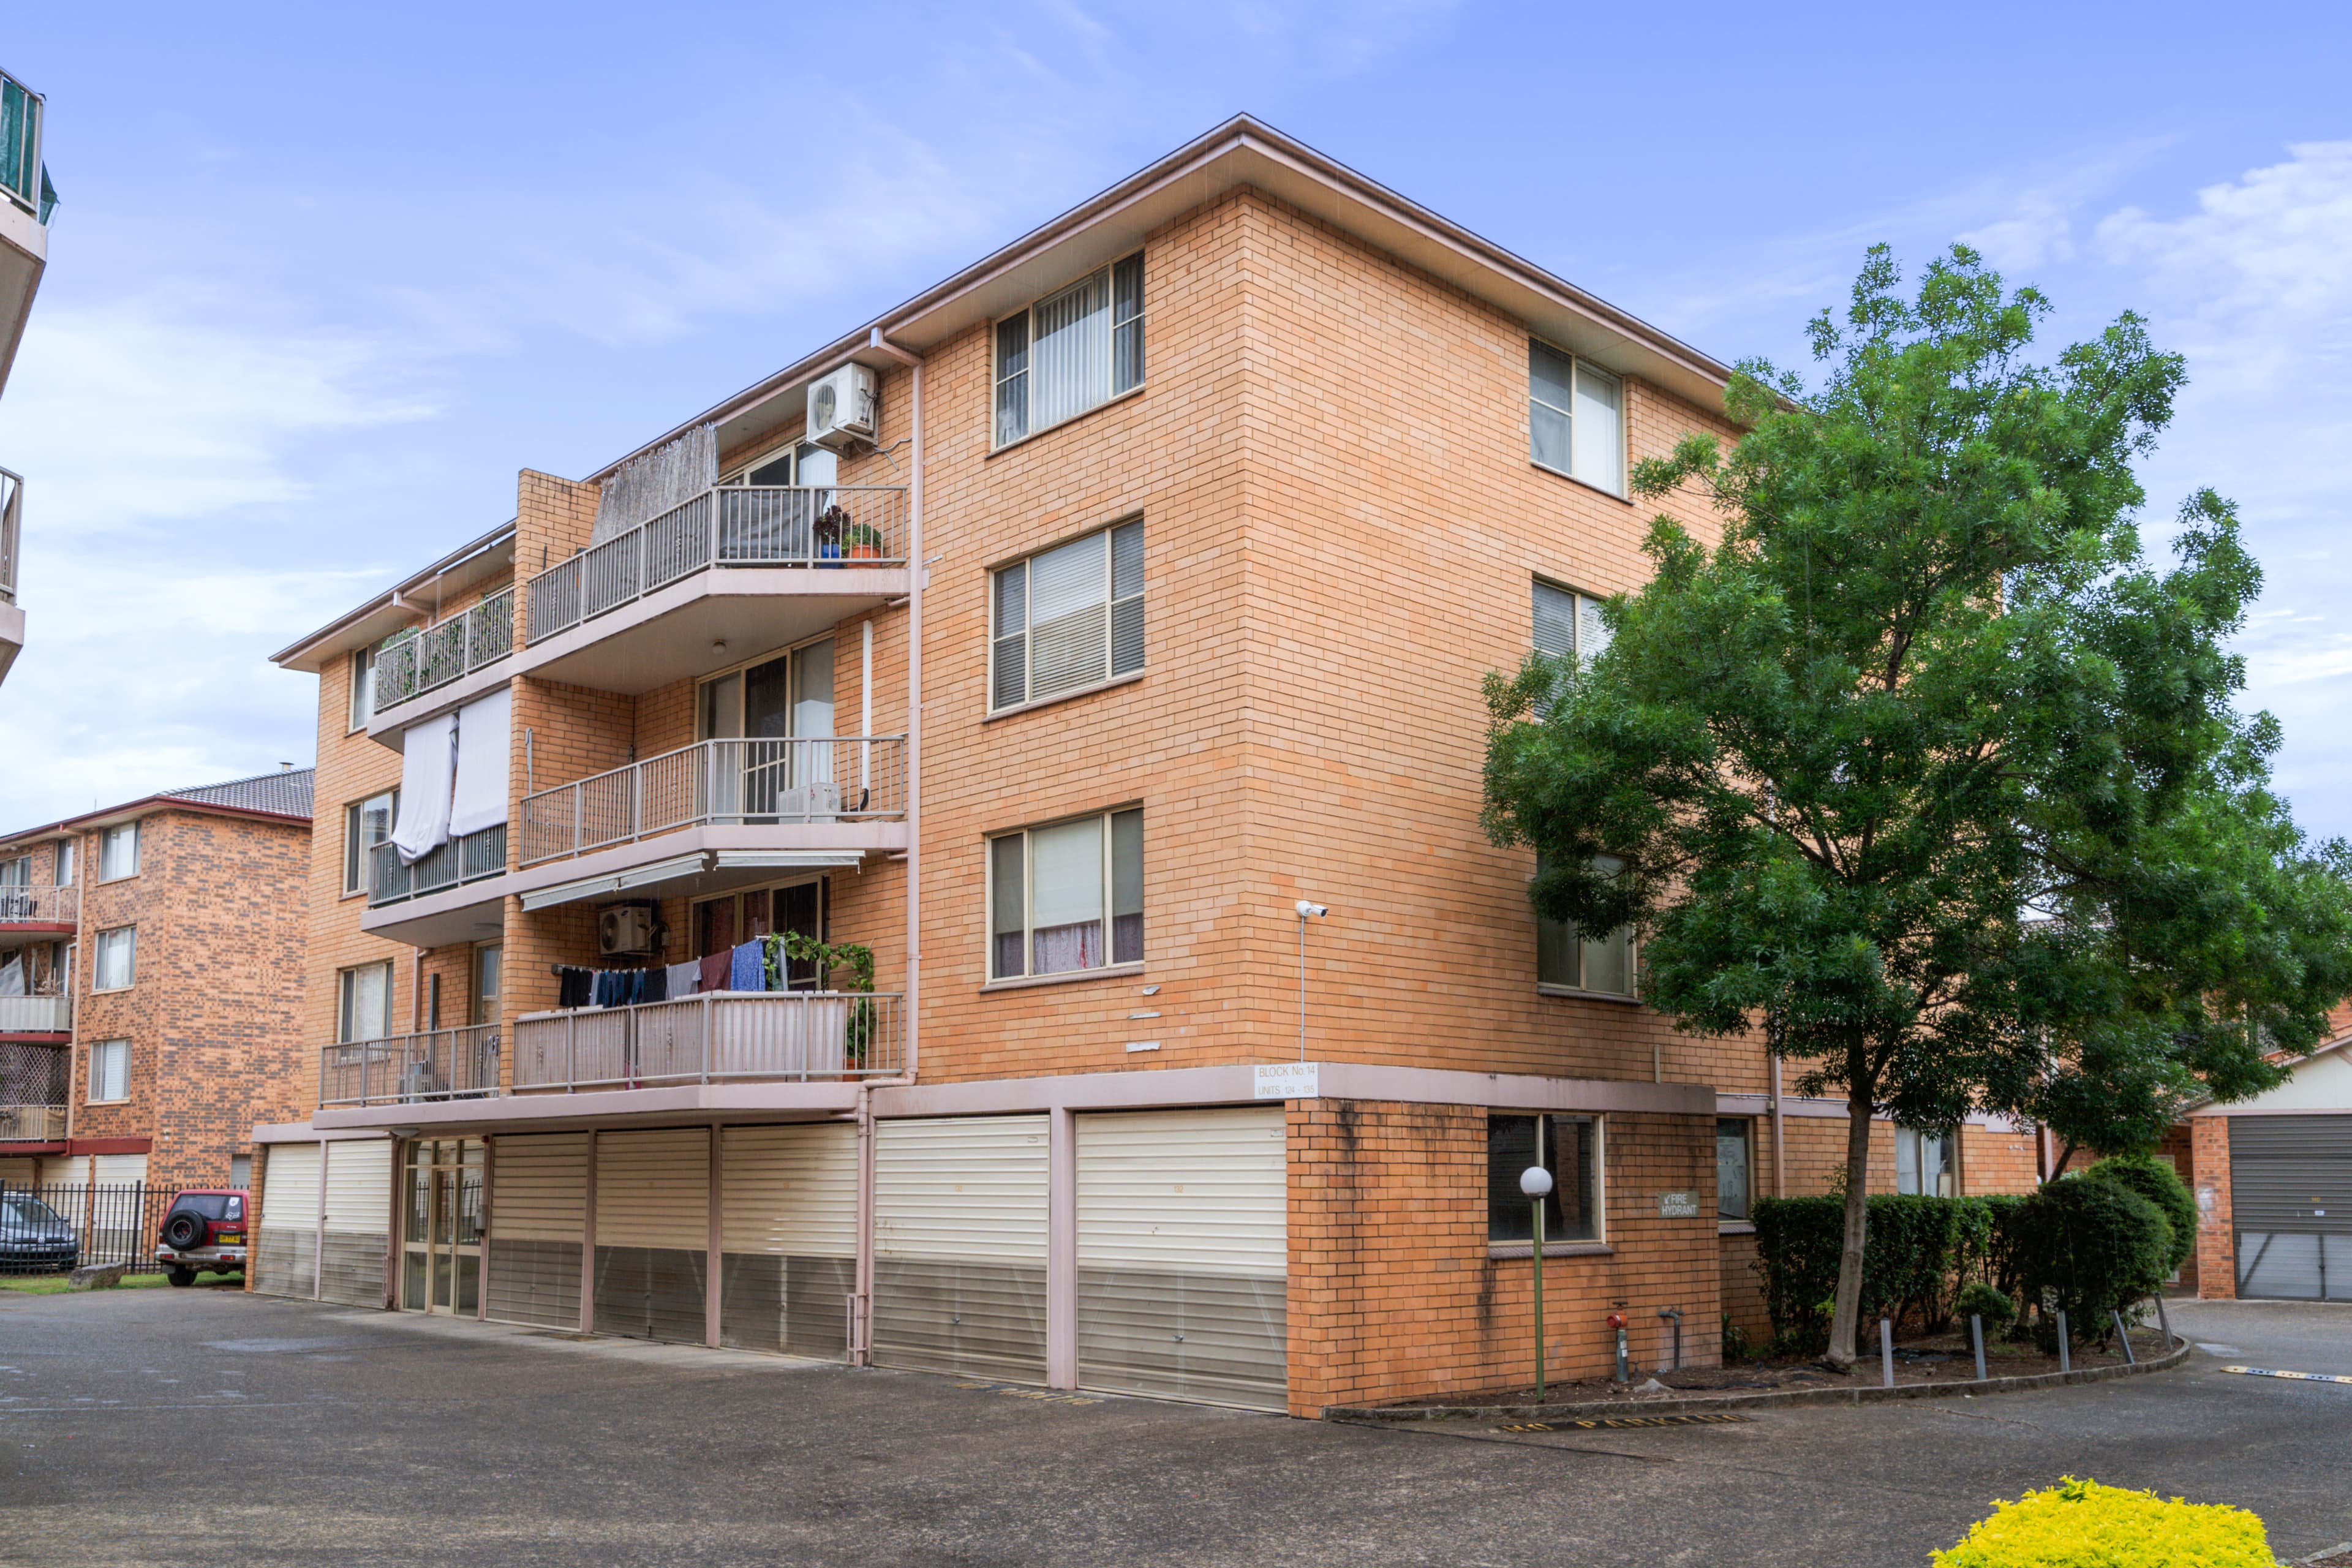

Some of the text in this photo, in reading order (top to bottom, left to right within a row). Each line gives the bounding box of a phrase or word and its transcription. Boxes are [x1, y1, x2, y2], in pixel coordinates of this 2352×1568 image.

[1259, 1066, 1288, 1077] BLOCK
[1307, 1065, 1315, 1076] 14
[1259, 1086, 1280, 1095] UNITS
[1671, 1193, 1687, 1204] FIRE
[1661, 1205, 1697, 1216] HYDRANT
